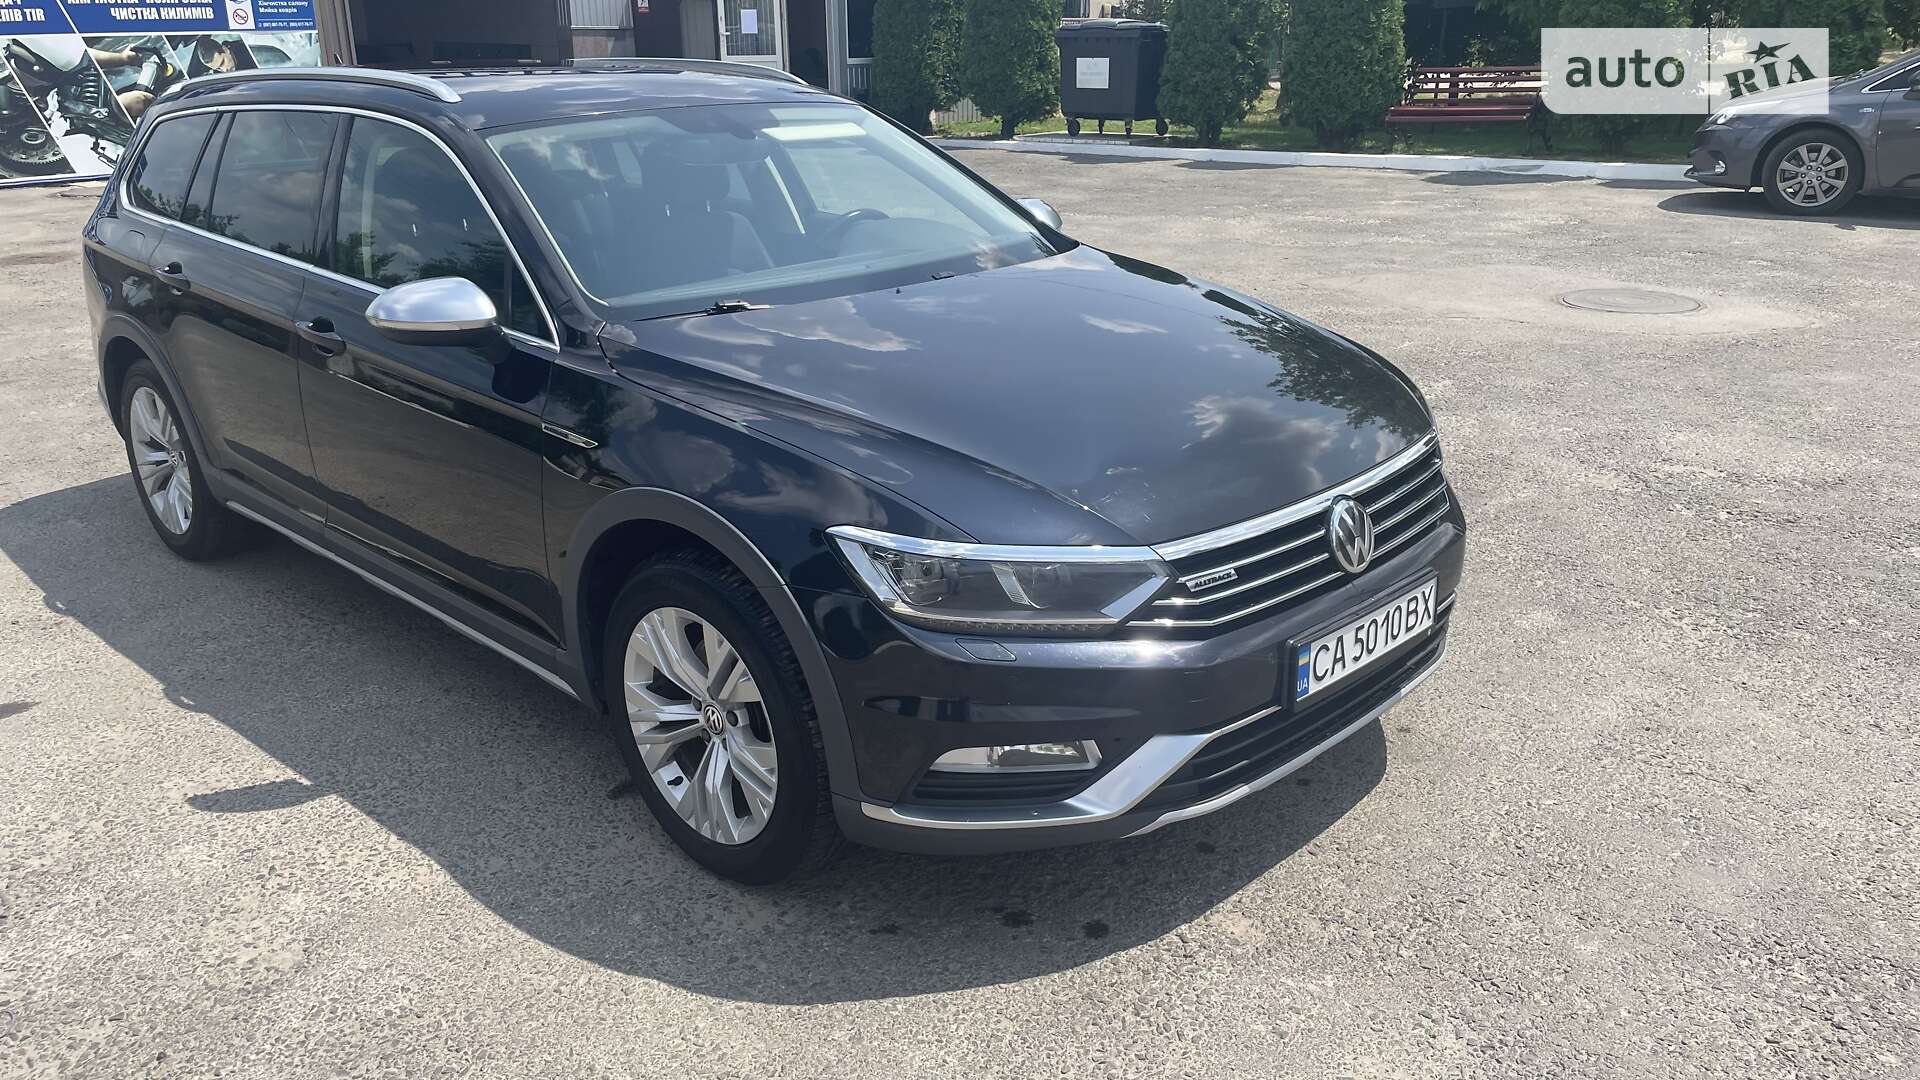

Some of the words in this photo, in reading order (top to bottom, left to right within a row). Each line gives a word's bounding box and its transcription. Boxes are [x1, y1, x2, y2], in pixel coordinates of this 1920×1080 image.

[0, 8, 22, 21] ПІВ
[23, 8, 45, 21] TIR
[110, 7, 159, 20] ЧИСТКА
[160, 7, 214, 19] КИЛИМІВ
[1194, 571, 1232, 589] ALLTRACK
[1313, 634, 1346, 682] CA
[1353, 604, 1402, 662] 5010
[1405, 585, 1434, 634] BX
[1297, 680, 1309, 692] UA
